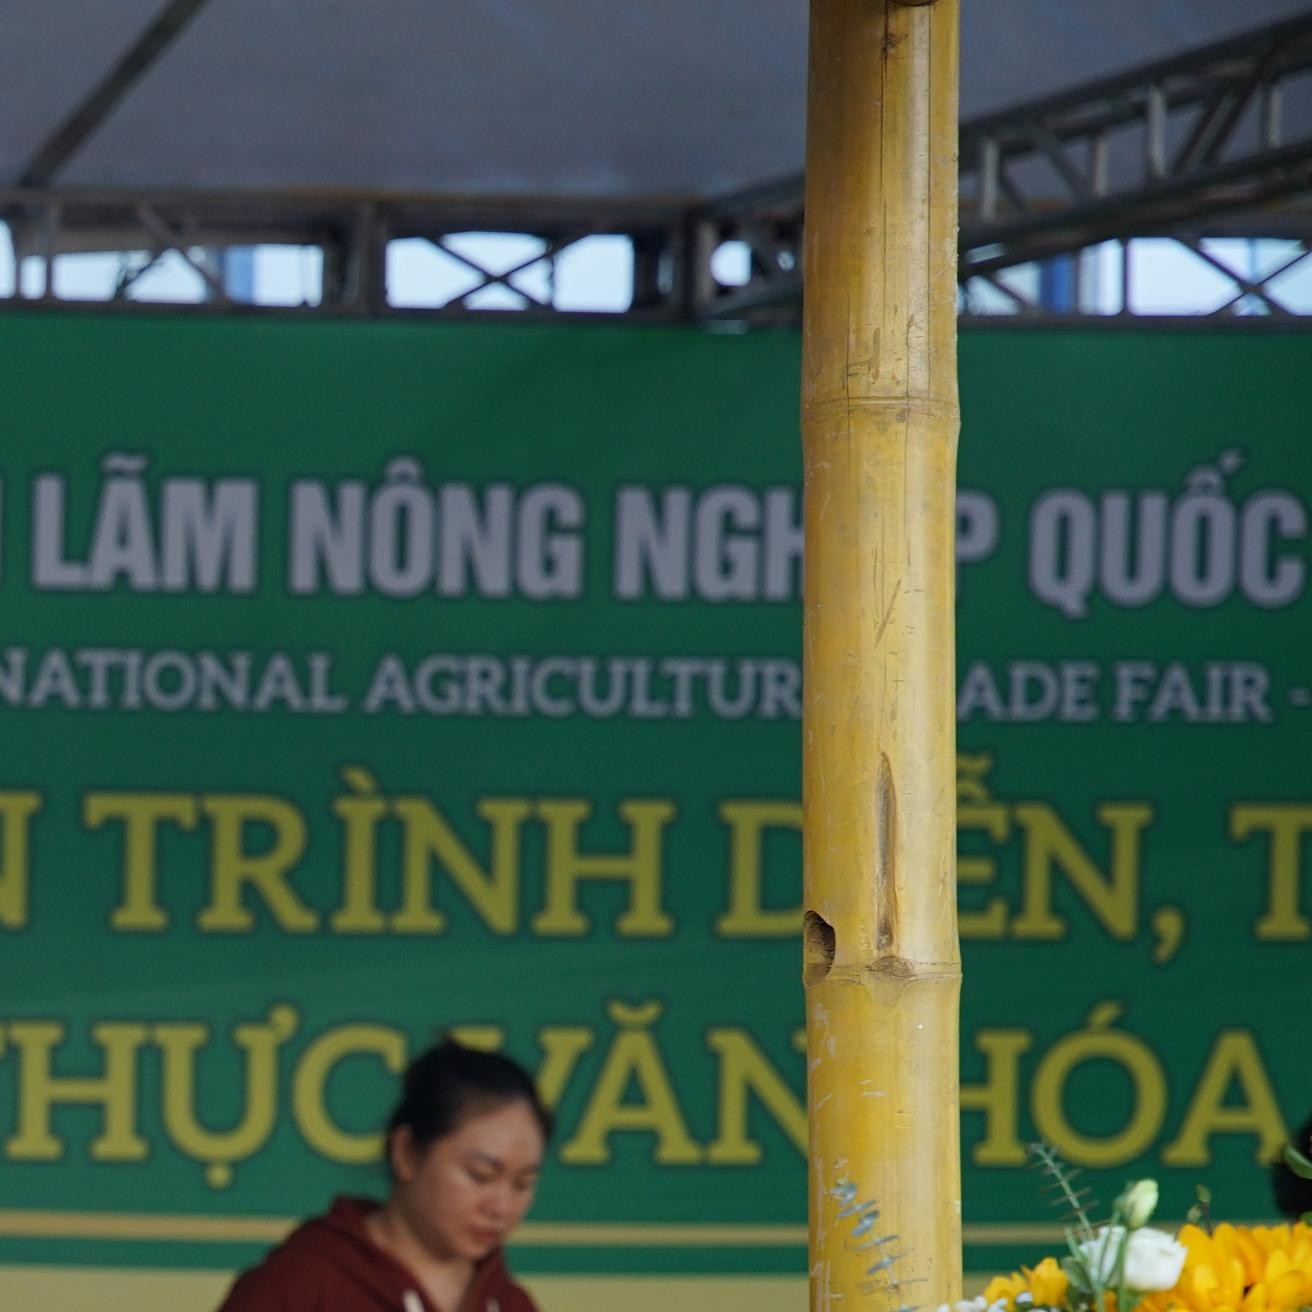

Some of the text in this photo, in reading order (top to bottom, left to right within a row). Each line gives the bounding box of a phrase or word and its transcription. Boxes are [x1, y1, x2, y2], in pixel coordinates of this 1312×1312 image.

[32, 452, 258, 591] LÃM
[291, 455, 584, 600] NÔNG
[614, 485, 998, 602] NGHP
[1028, 450, 1308, 618] QUỐC
[363, 653, 804, 722] AGRICULTUR
[956, 658, 1098, 722] ADE
[1116, 663, 1274, 724] FAIR
[83, 767, 675, 937] TRÌNH
[717, 753, 1184, 963] DỄN,
